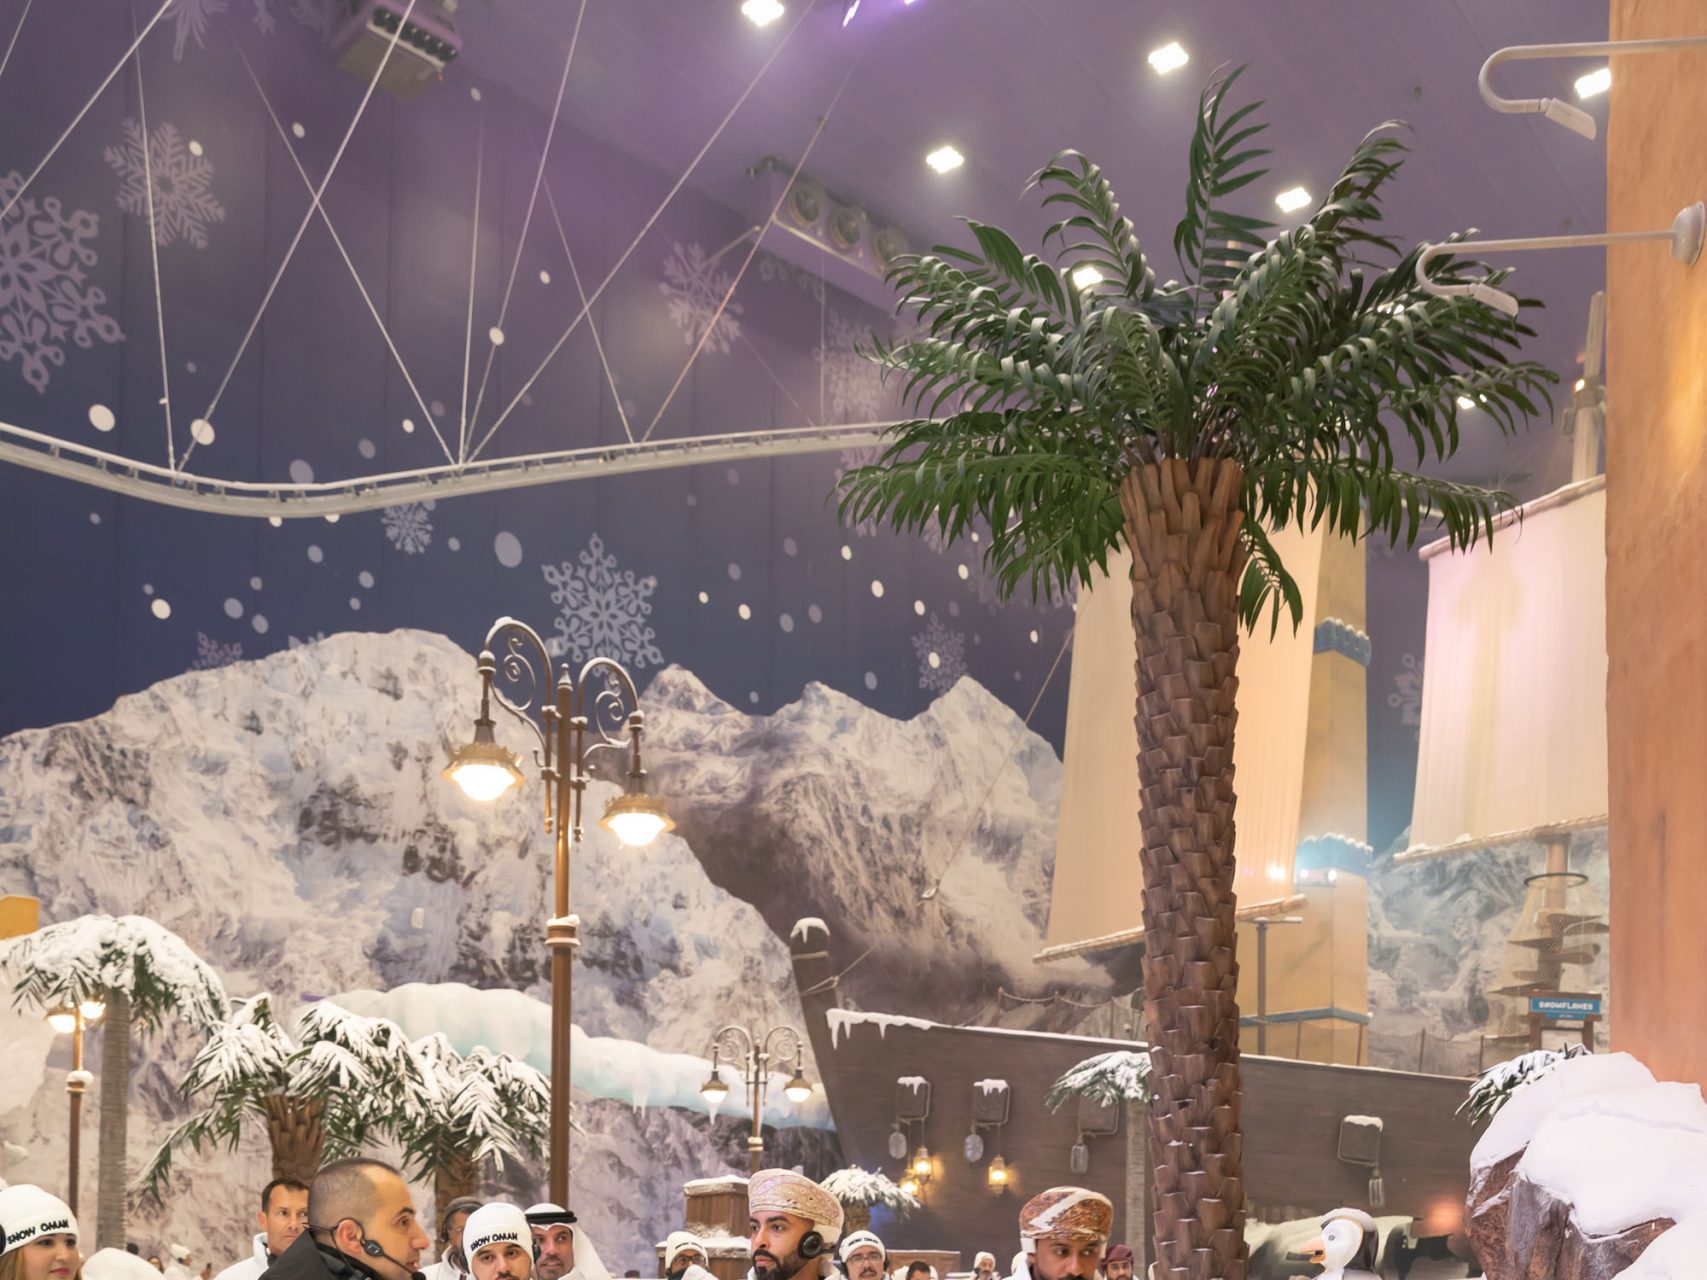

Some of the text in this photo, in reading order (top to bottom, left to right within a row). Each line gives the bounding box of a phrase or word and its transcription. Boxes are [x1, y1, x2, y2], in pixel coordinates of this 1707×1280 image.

[7, 1219, 70, 1245] SNOW OMAN
[470, 1232, 518, 1252] SNOW OMAN
